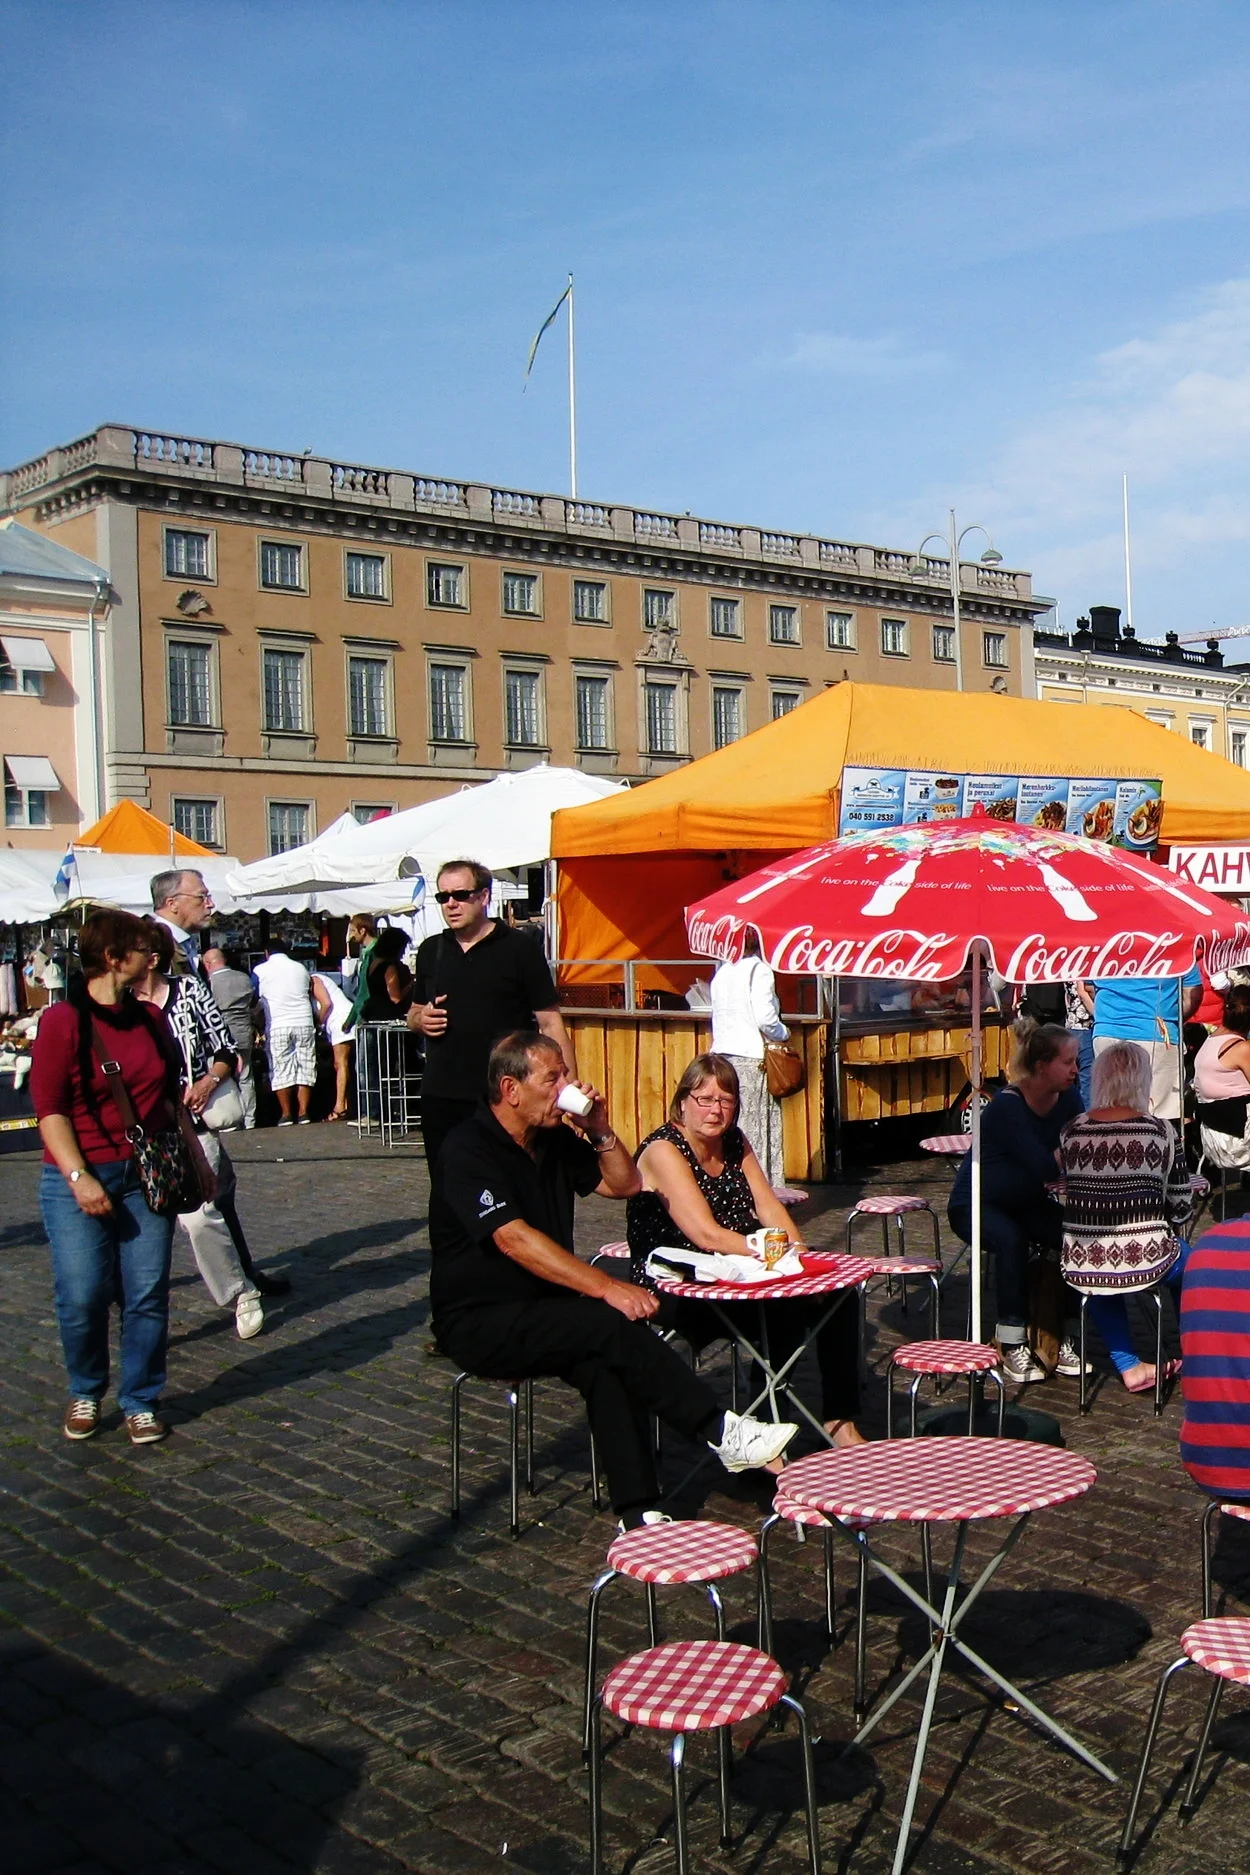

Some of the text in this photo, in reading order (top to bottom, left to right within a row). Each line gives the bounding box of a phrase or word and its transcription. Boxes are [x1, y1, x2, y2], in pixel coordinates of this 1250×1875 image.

[849, 812, 862, 820] 040
[863, 813, 875, 821] 591
[821, 876, 842, 885] live
[860, 878, 880, 886] the
[914, 881, 938, 889] side
[940, 881, 954, 889] of
[955, 881, 972, 890] life
[987, 884, 1008, 892] live
[1026, 884, 1045, 892] the
[1079, 884, 1102, 892] side
[1103, 884, 1117, 892] of
[1118, 883, 1136, 892] life
[771, 925, 958, 981] Coca-Cola
[1005, 931, 1184, 983] Coca-Cola
